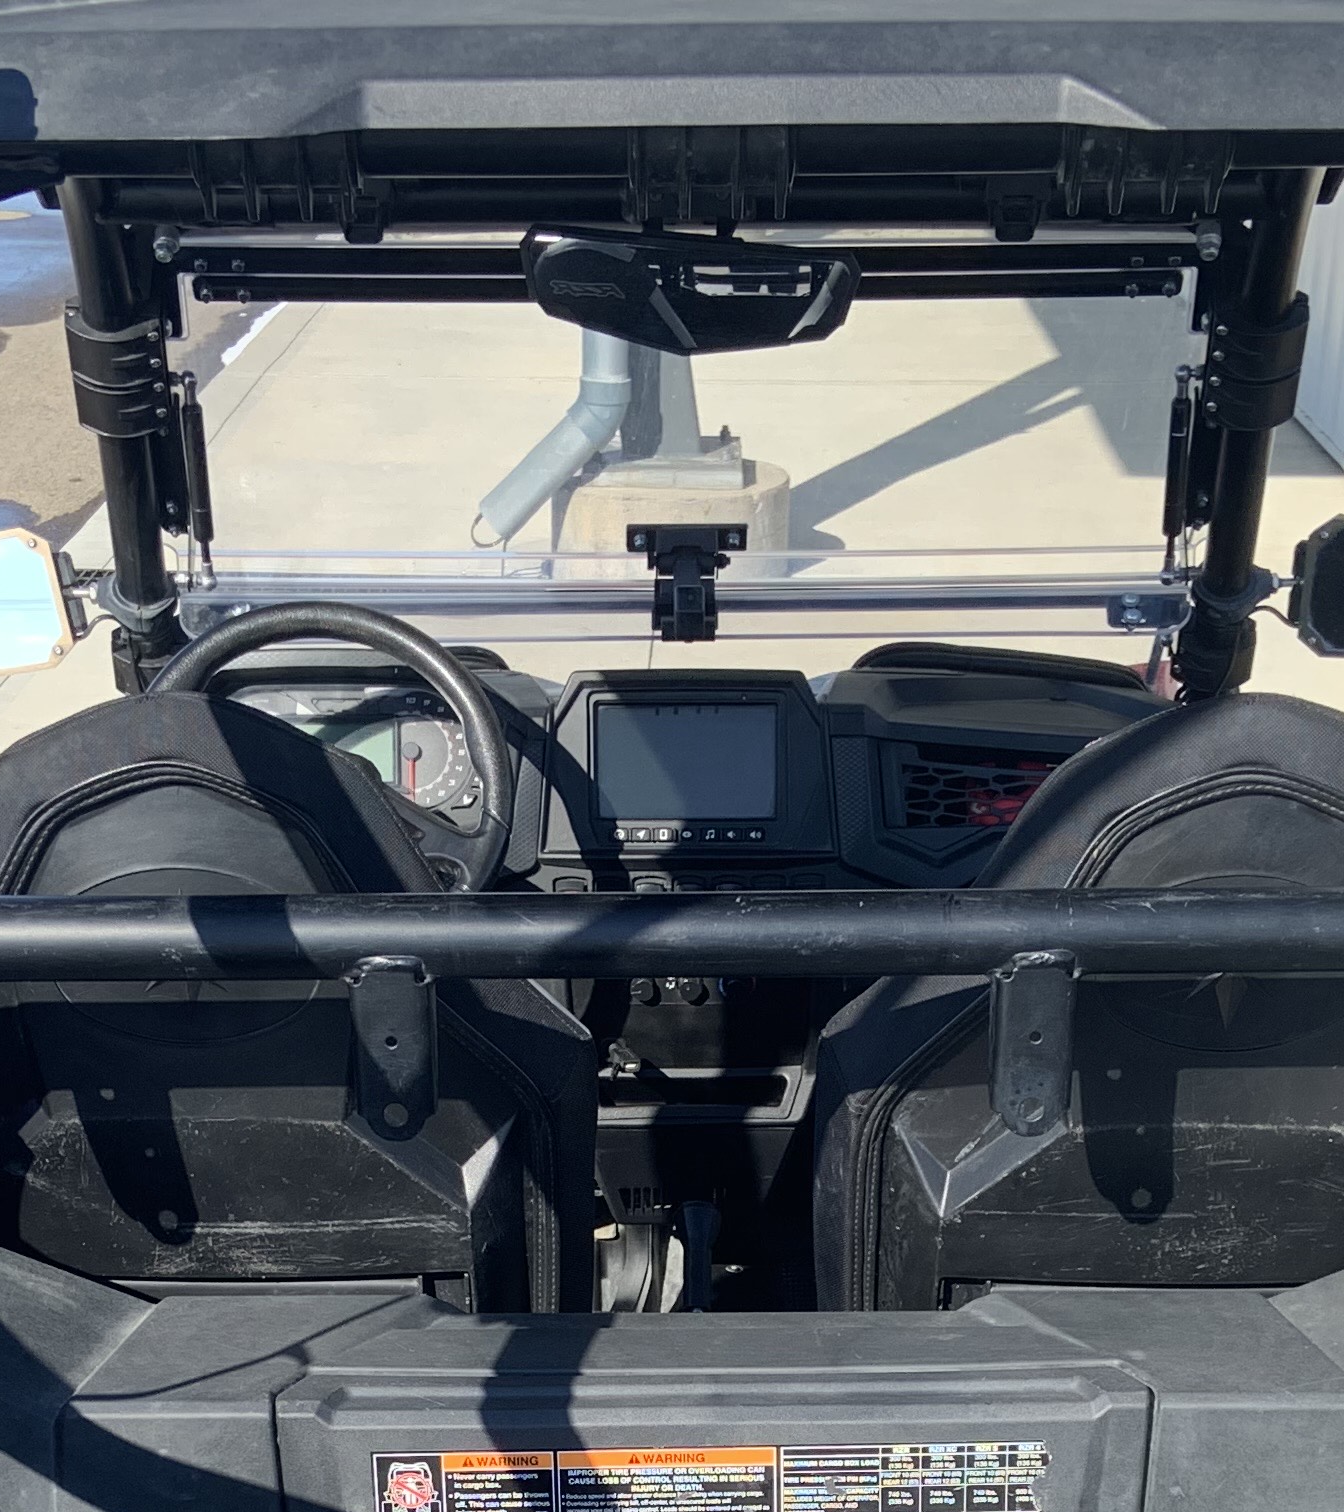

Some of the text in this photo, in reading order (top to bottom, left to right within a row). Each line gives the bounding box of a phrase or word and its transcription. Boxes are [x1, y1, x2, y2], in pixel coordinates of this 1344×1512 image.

[477, 1456, 538, 1466] WARNING
[643, 1453, 705, 1463] WARNING
[496, 1473, 538, 1481] passengers
